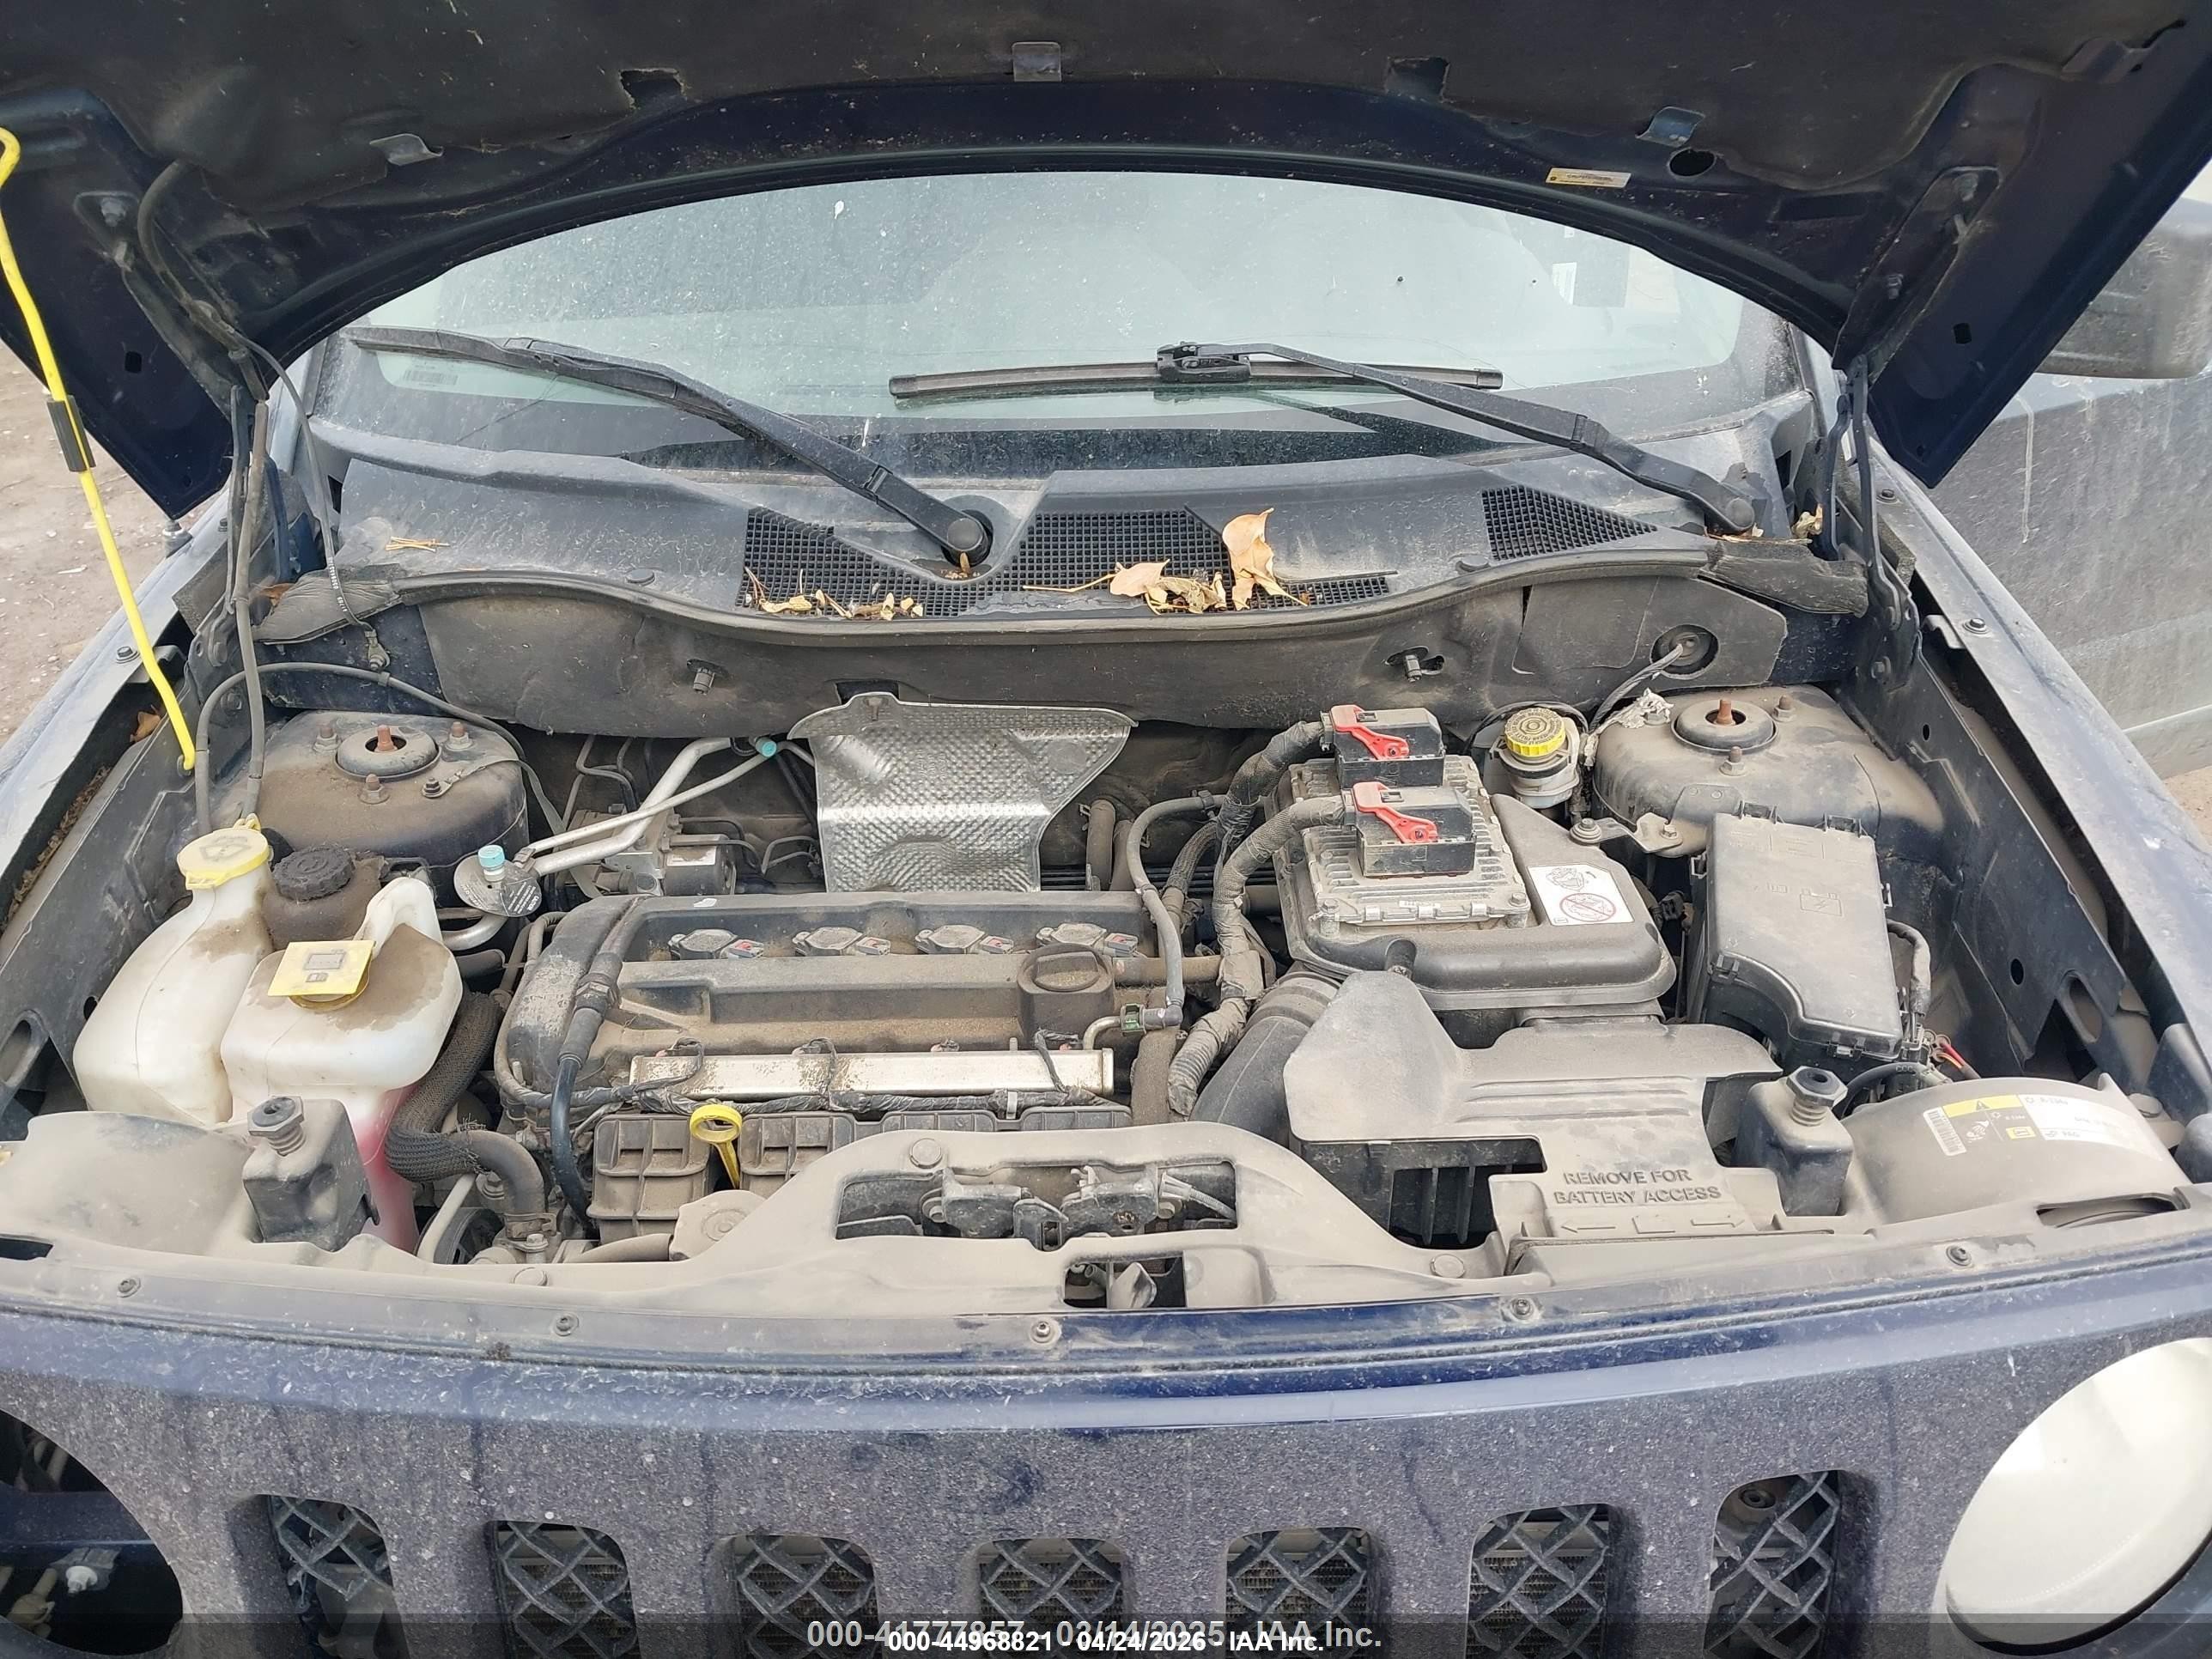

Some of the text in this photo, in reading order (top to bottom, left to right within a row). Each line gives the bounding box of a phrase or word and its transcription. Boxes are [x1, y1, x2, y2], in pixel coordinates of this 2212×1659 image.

[1563, 1169, 1692, 1185] REMOVE FOR
[1553, 1185, 1723, 1205] BATTERY ACCESS
